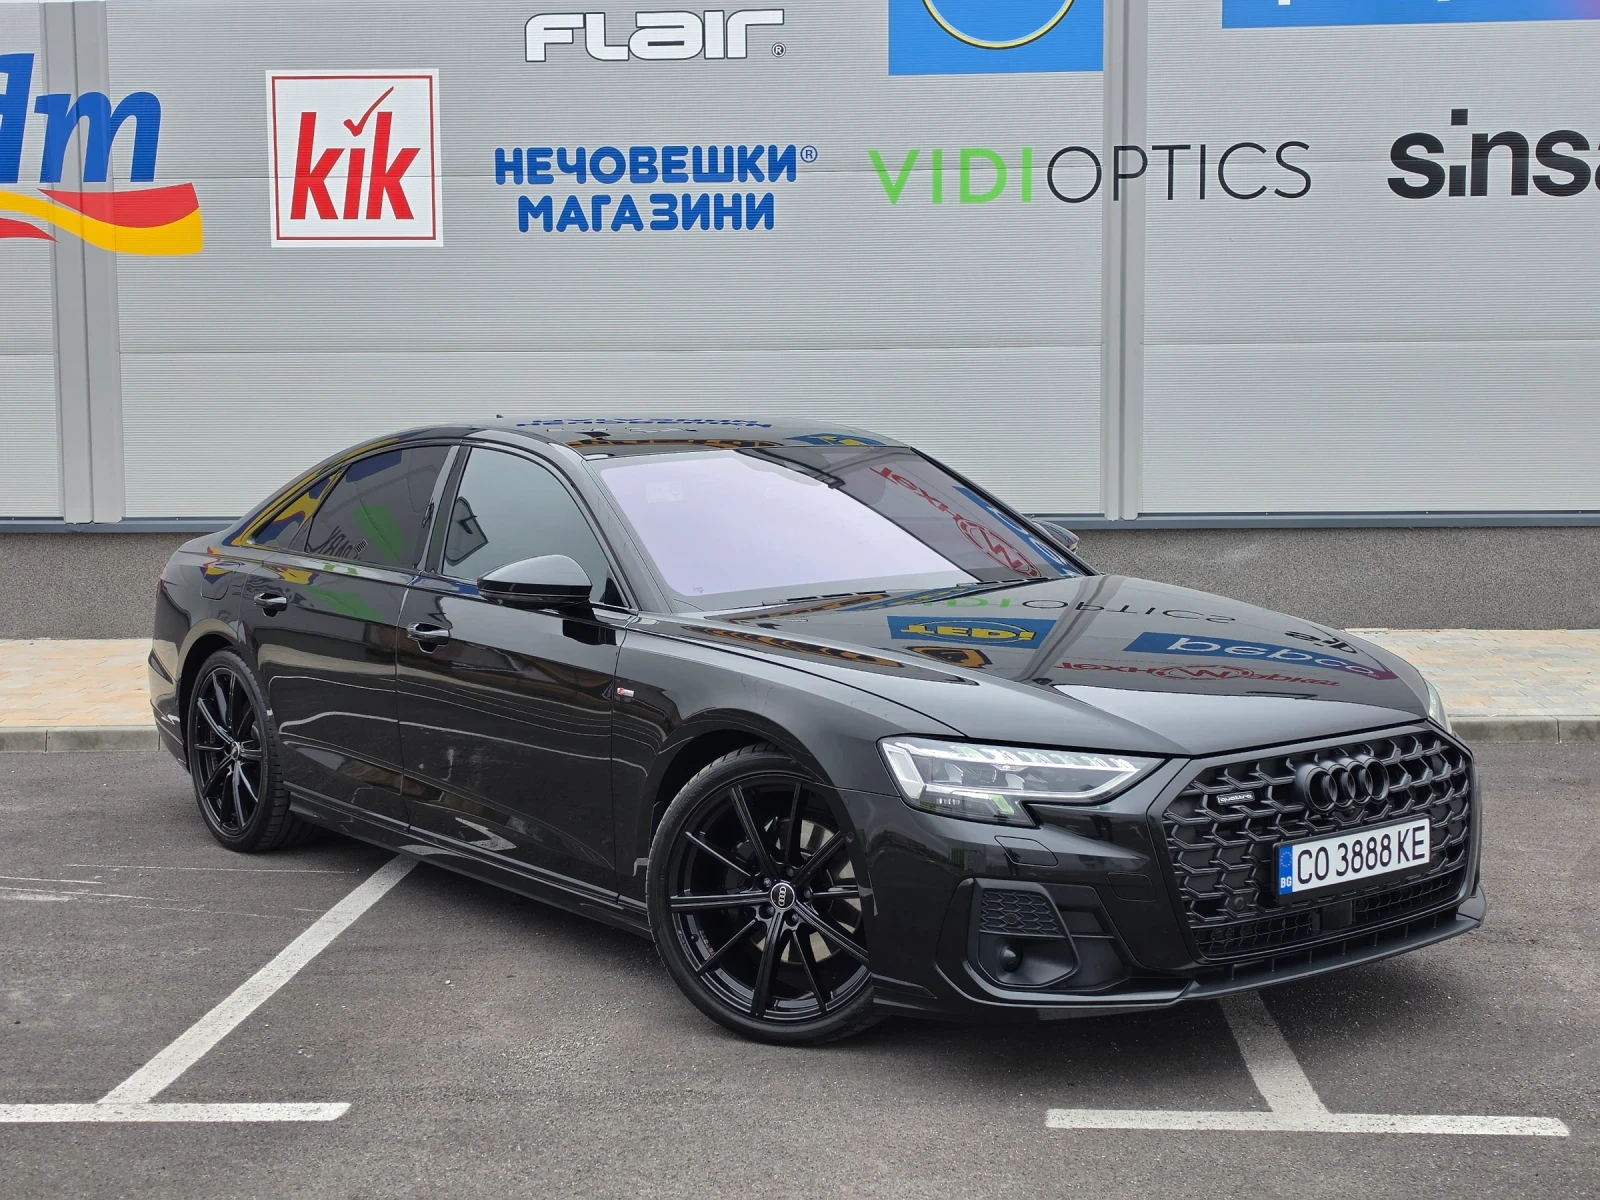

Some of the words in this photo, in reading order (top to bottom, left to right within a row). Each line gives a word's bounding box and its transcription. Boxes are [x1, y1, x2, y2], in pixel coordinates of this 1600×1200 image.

[290, 87, 421, 220] kik
[494, 144, 797, 186] НЕЧОВЕШКИ
[1387, 108, 1600, 200] sins
[518, 192, 775, 233] МАГАЗИНИ
[1335, 834, 1392, 877] 3888
[1397, 825, 1426, 865] KE
[1280, 876, 1293, 889] BG
